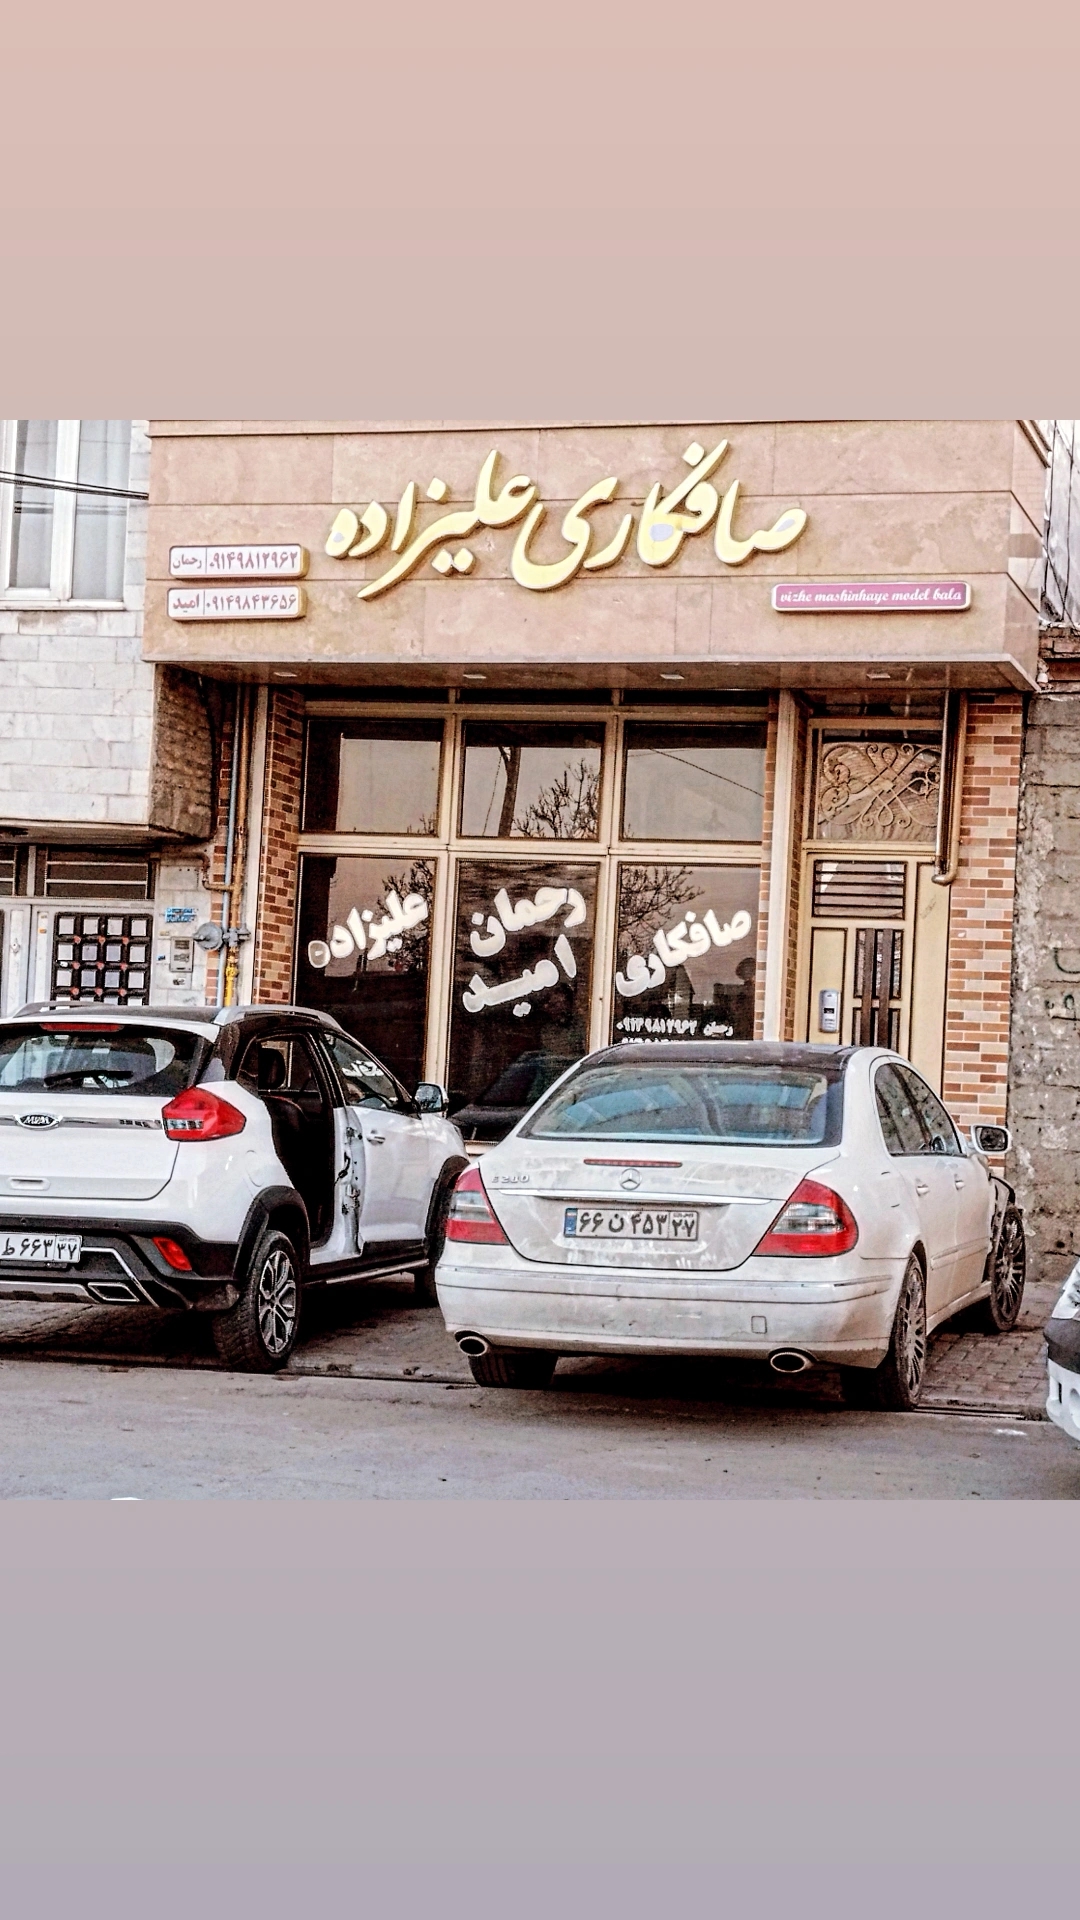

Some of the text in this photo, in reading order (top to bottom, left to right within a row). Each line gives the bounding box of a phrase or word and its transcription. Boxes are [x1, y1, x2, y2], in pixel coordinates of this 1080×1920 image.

[325, 438, 808, 600] صافکاری علیزاده
[172, 551, 298, 570] رحمان ۰۹۱۴۹۸۱۲۹۶۲
[780, 586, 962, 604] vizhe mashinhaye model bala
[172, 593, 297, 613] امید ۰۹۱۴۹۸۴۳۶۵۶
[308, 889, 428, 969] علیزاده
[470, 887, 587, 957] رحمان
[615, 909, 752, 997] صافکاری
[462, 934, 577, 1018] امید
